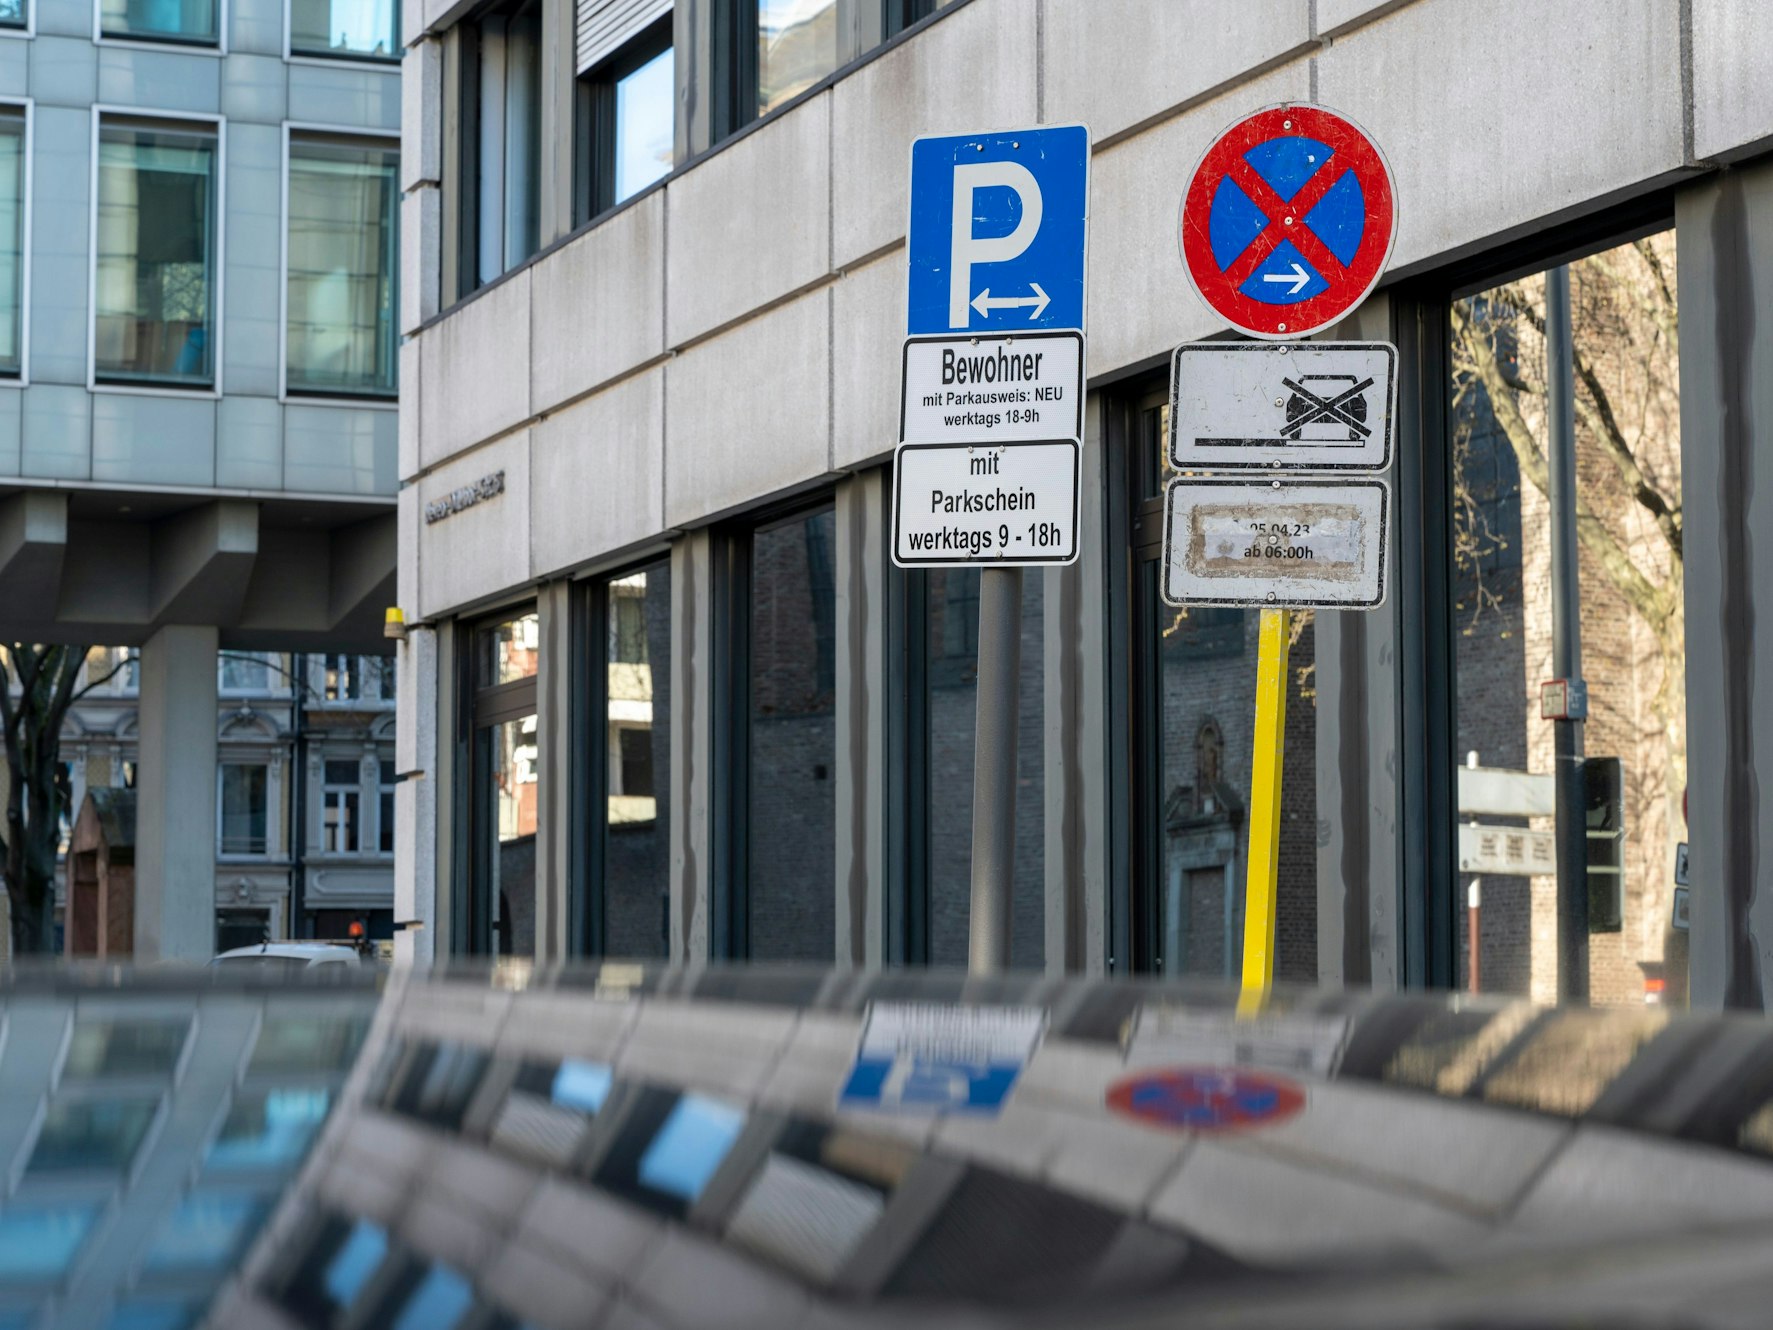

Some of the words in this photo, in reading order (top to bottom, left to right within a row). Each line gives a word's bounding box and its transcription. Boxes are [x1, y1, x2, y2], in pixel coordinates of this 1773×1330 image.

[949, 161, 1043, 329] P
[942, 346, 1043, 385] Bewohner
[923, 392, 943, 407] mit
[946, 388, 1031, 406] Parkausweis:
[1035, 386, 1063, 402] NEU
[944, 411, 1001, 428] werktags
[1005, 408, 1040, 424] 18-9h
[970, 451, 1000, 476] mit
[931, 486, 1036, 514] Parkschein
[909, 525, 992, 555] werktags
[998, 524, 1009, 548] 9
[1028, 522, 1061, 547] 18h
[1250, 523, 1311, 537] 0504.23
[1244, 545, 1261, 559] ab
[1265, 545, 1314, 560] 06:00h
